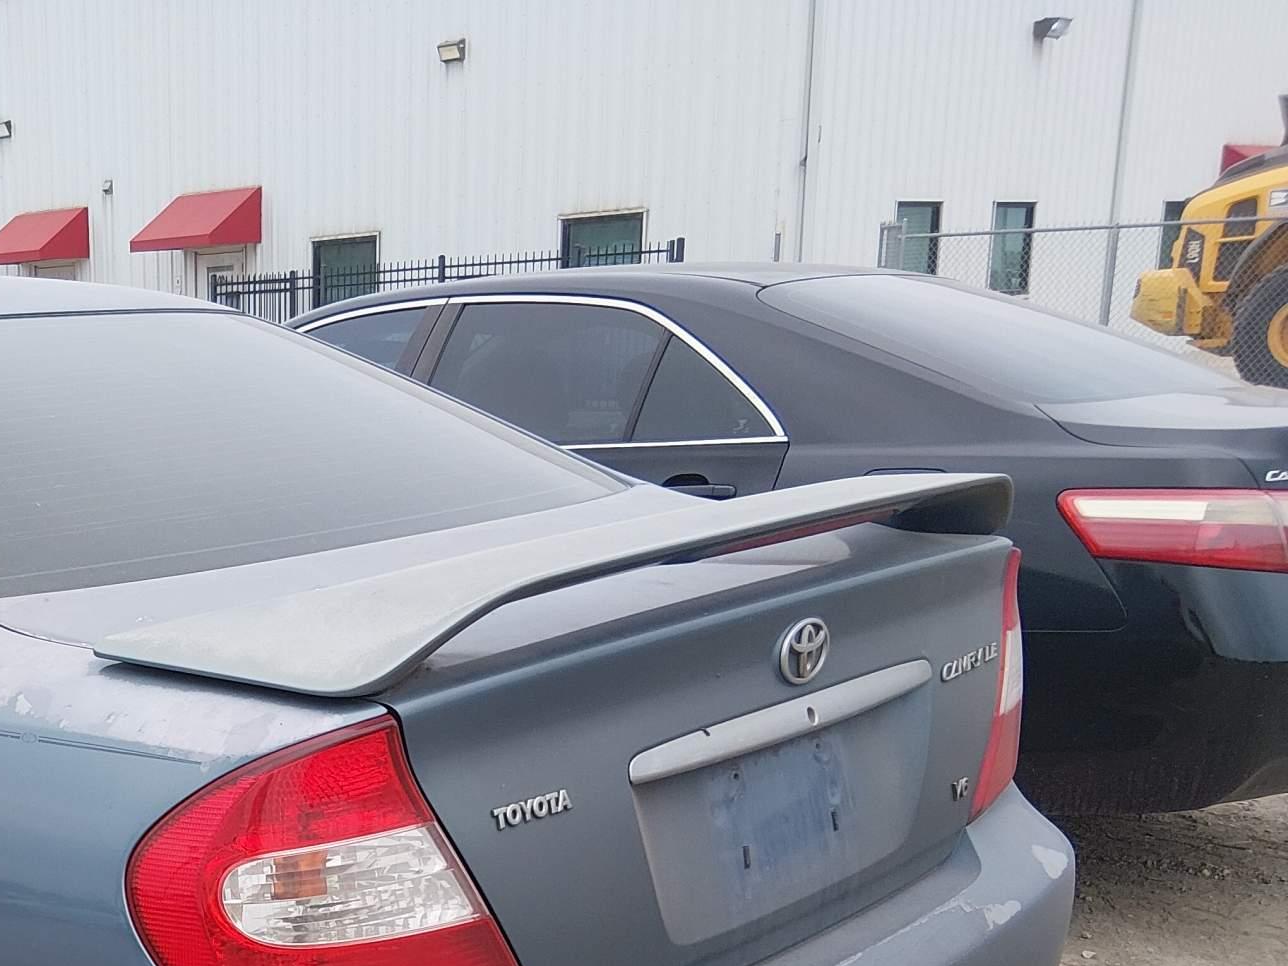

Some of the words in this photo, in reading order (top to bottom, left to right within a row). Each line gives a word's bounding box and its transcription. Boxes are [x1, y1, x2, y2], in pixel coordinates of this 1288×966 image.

[984, 642, 998, 661] LE
[951, 777, 969, 801] V6
[492, 789, 573, 830] TOYOTA
